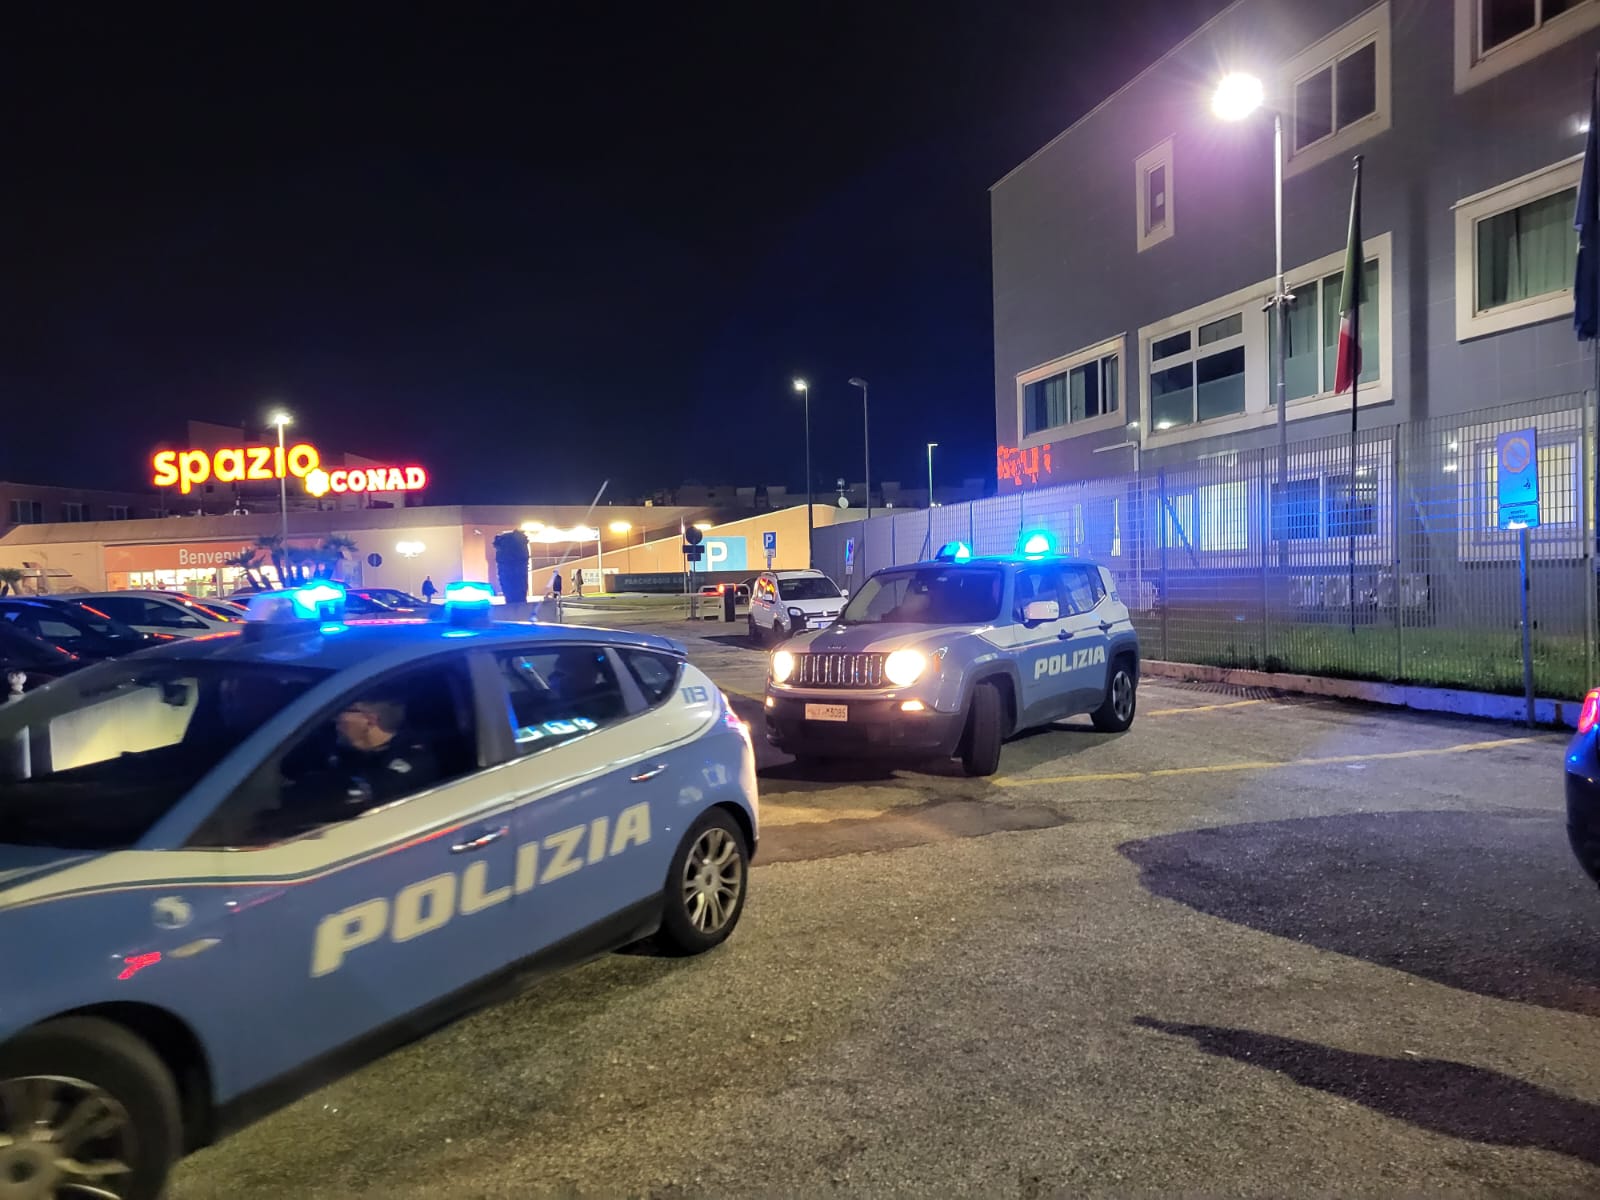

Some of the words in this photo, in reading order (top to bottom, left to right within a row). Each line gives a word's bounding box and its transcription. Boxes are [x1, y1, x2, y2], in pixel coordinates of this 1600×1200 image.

[153, 444, 320, 494] spazio
[329, 466, 427, 492] CONAD
[706, 541, 728, 572] P
[765, 533, 774, 548] P
[1033, 645, 1106, 680] POLIZIA
[310, 801, 652, 978] POLIZIA
